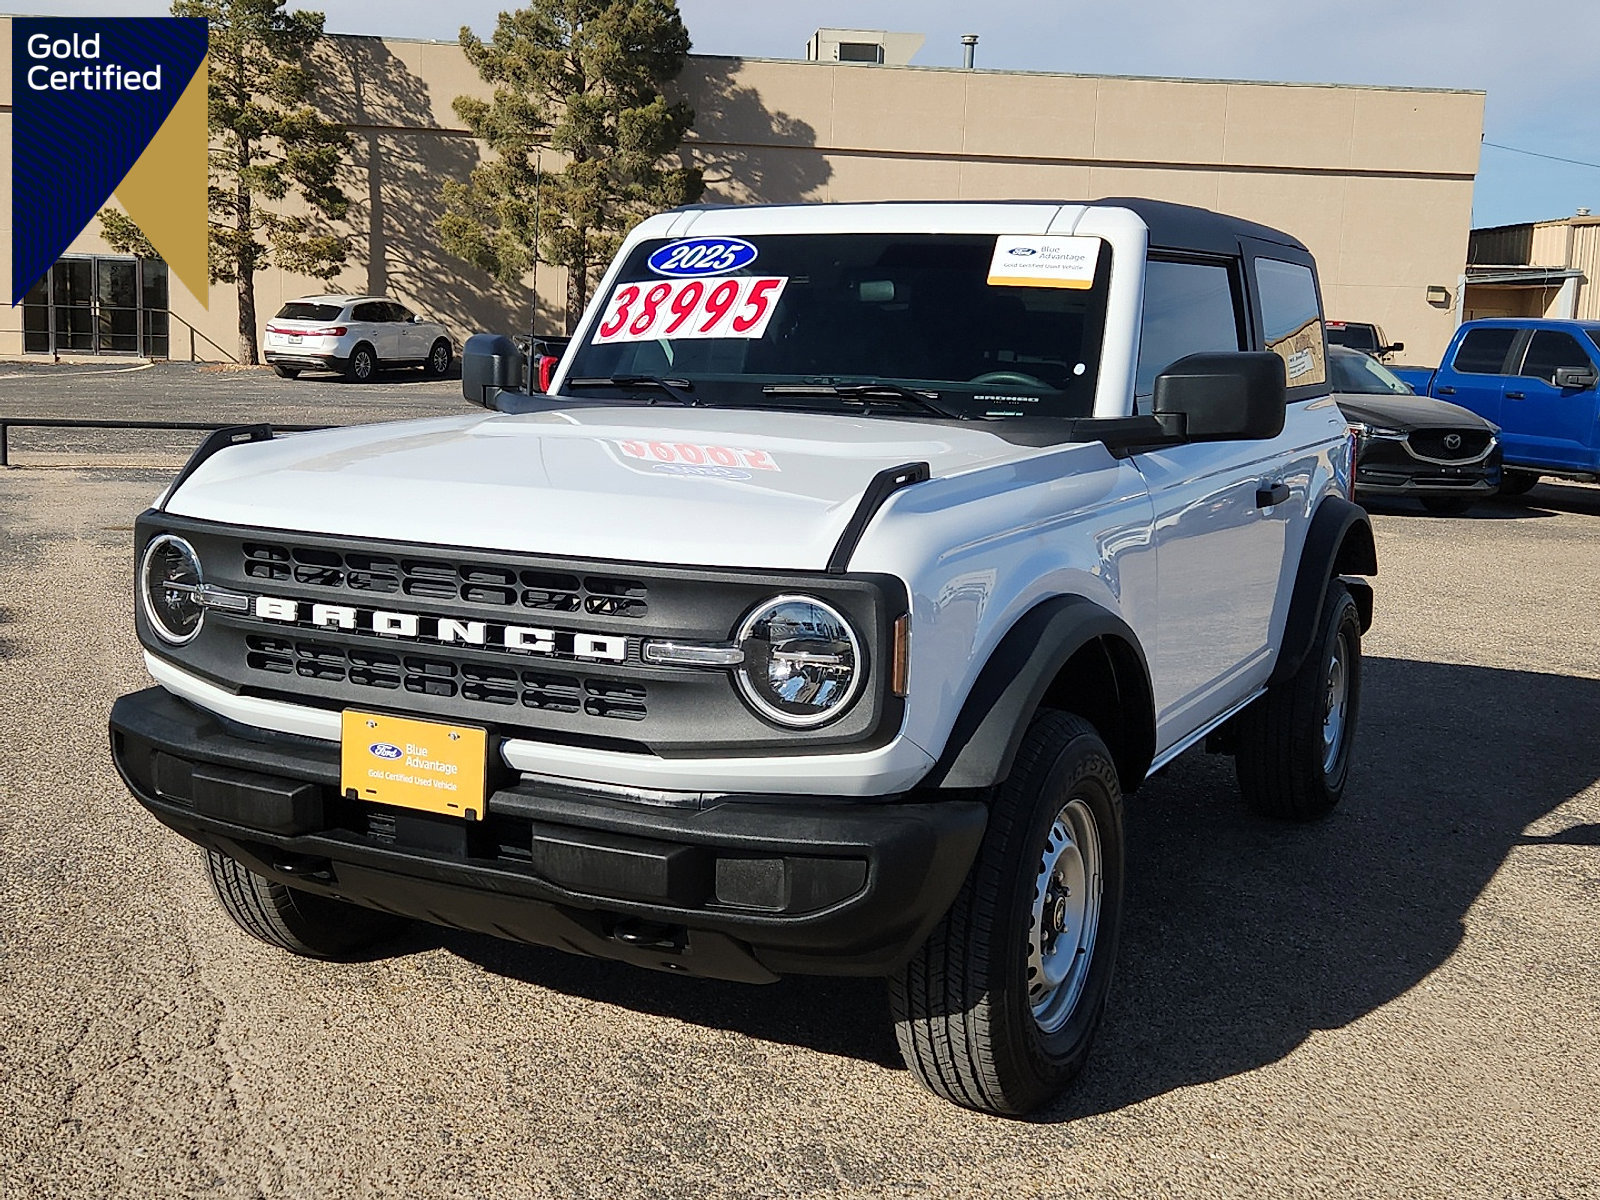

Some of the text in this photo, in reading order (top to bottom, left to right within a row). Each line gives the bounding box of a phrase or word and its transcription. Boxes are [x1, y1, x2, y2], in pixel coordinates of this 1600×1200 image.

[659, 244, 746, 270] 2025
[1039, 253, 1085, 261] Advantage
[599, 279, 782, 338] 38995
[255, 596, 628, 661] BRONCO
[374, 745, 398, 758] Ford
[405, 744, 428, 756] Blue
[405, 756, 458, 775] Advantage
[368, 769, 457, 791] Gold Certified Used Vehicle
